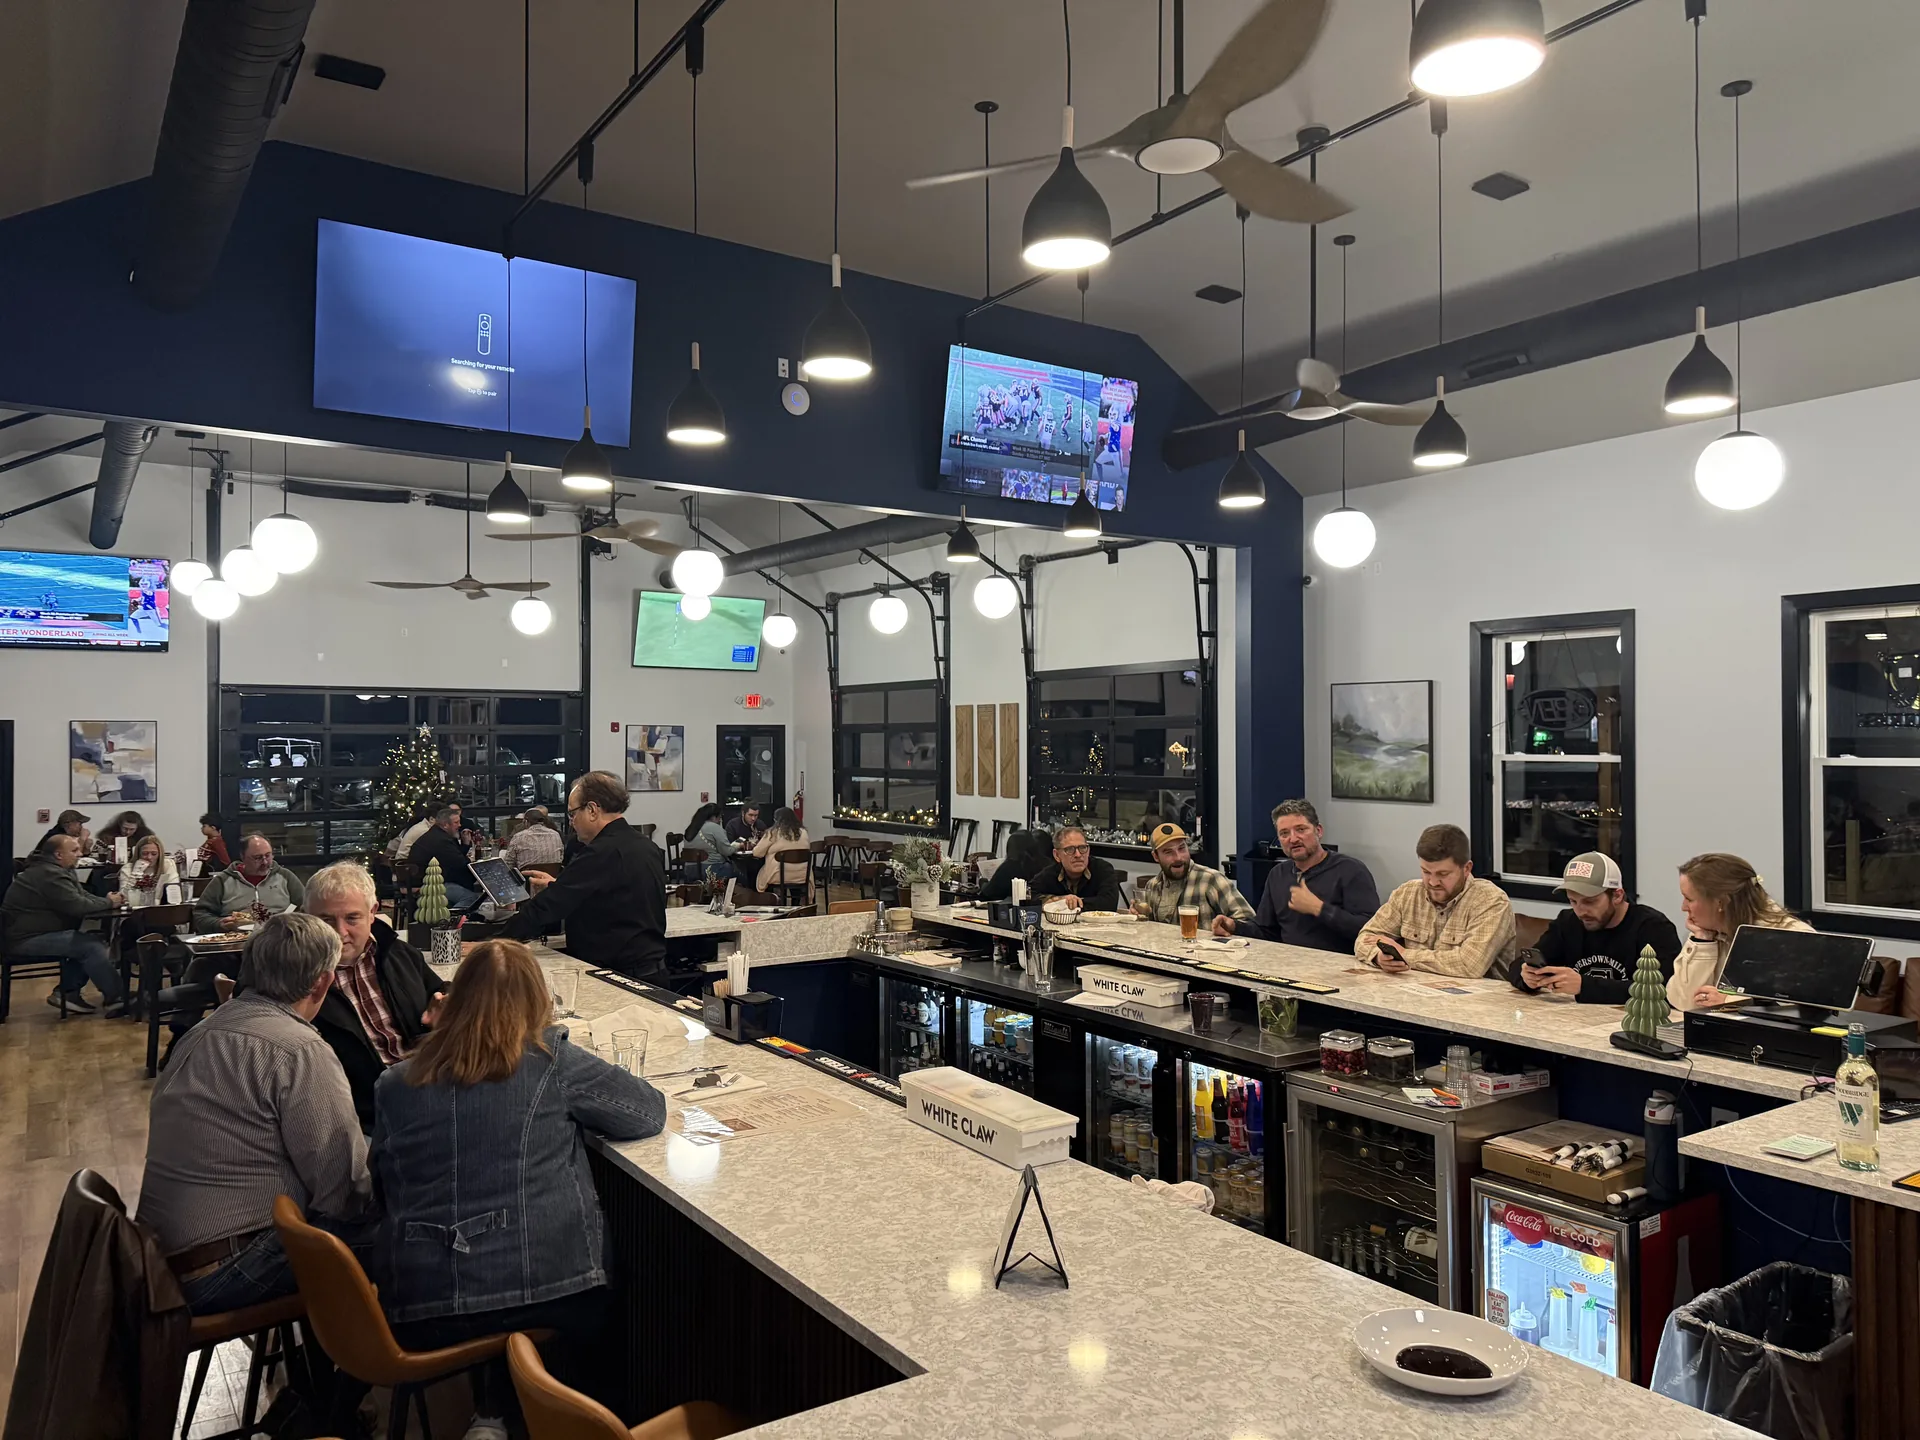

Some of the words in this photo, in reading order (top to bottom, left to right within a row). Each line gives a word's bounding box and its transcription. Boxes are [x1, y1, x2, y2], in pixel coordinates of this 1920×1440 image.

[451, 358, 476, 367] Searching
[20, 629, 84, 637] WONDERLAND
[746, 695, 760, 708] EXIT
[1092, 977, 1119, 992] WHITE
[1121, 984, 1145, 997] CLAW
[921, 1098, 958, 1131] WHITE
[961, 1117, 996, 1146] CLAW
[1505, 1210, 1542, 1231] Coca-Cola
[1549, 1224, 1568, 1238] ICE
[1570, 1232, 1601, 1247] COLD
